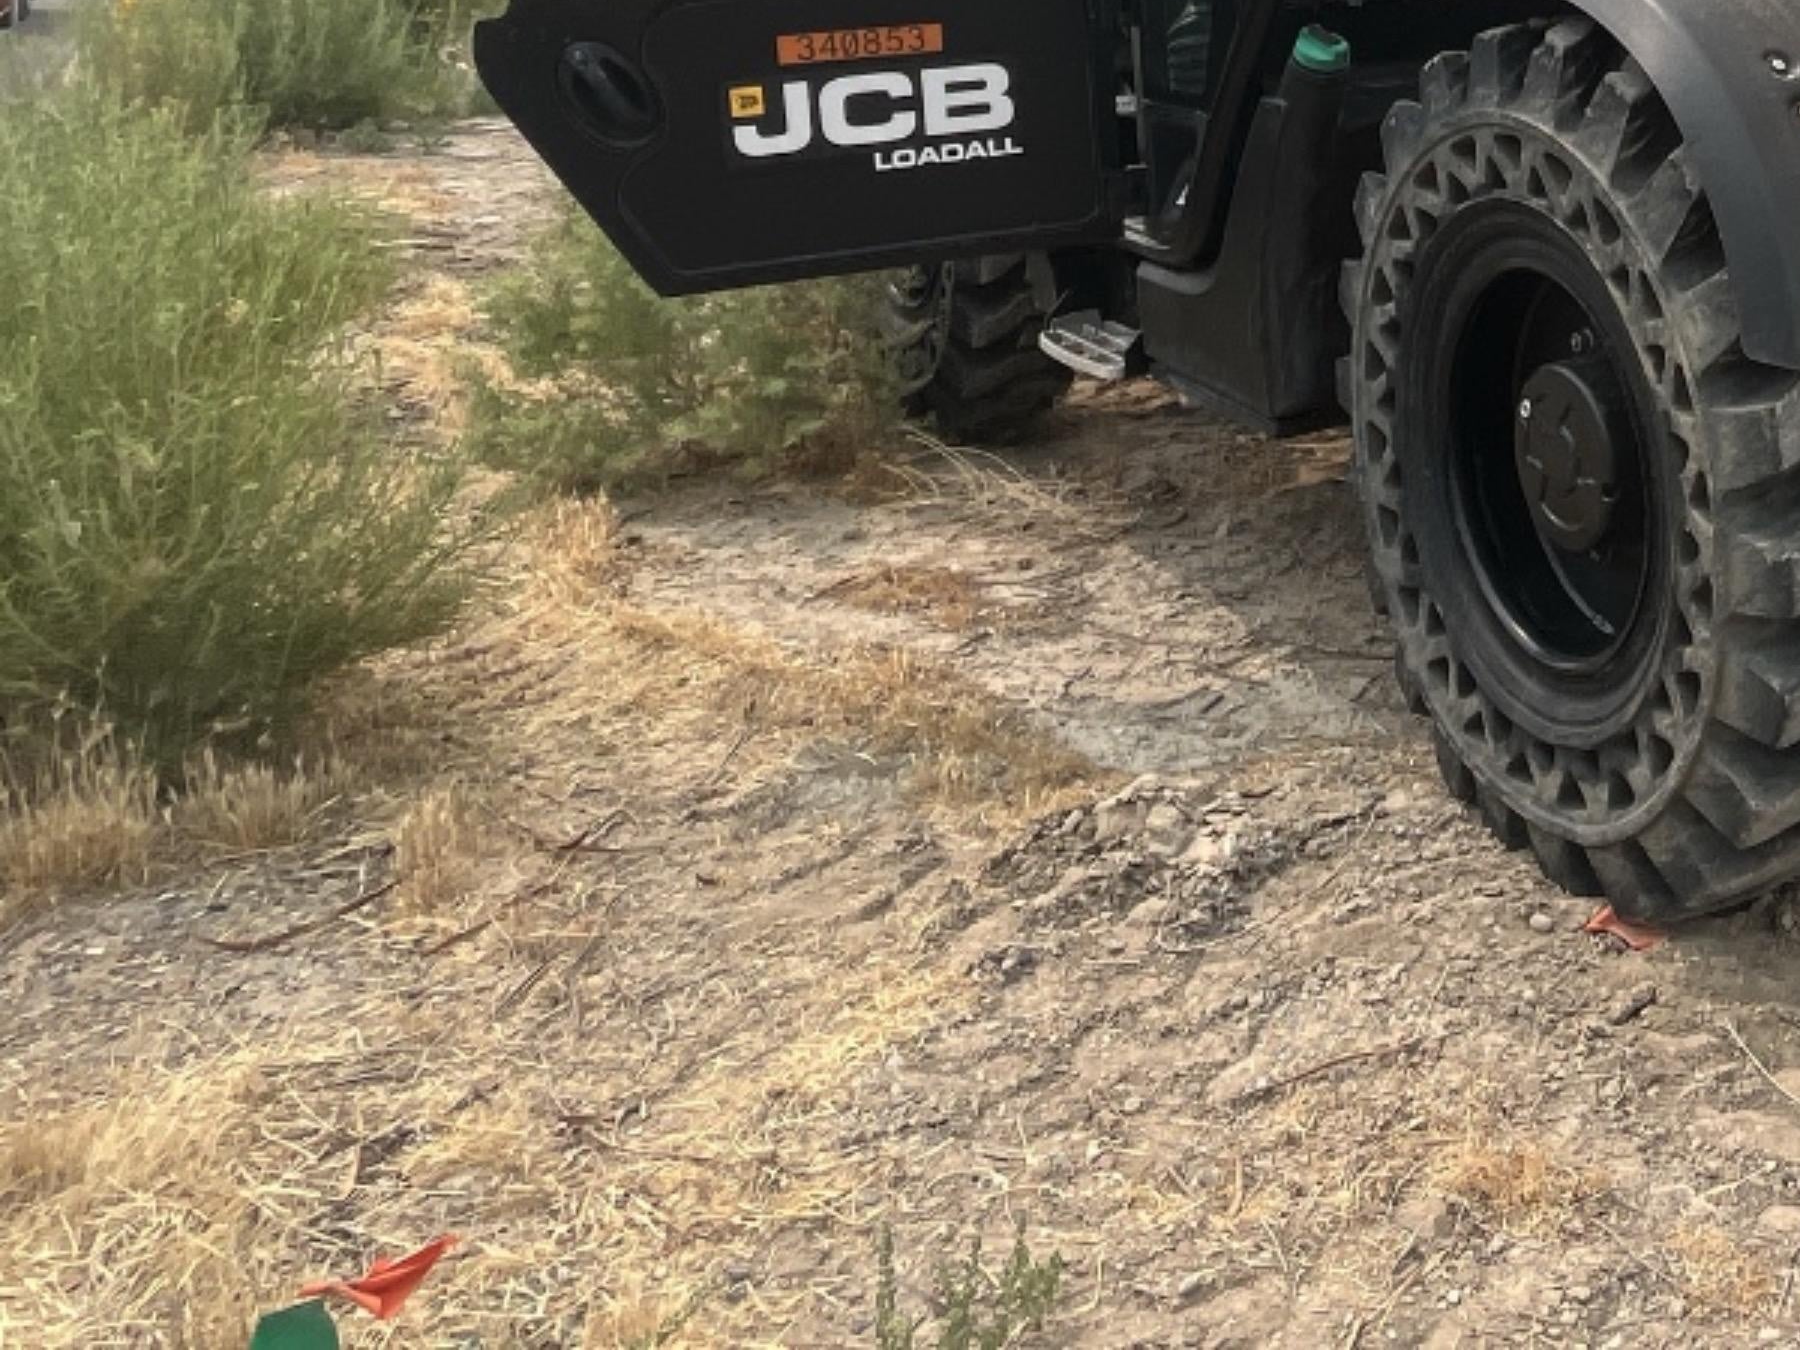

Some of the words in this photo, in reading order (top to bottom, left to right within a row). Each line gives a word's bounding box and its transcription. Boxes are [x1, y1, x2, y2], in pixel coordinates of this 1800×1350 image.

[797, 26, 925, 61] 340853
[732, 63, 1015, 157] JCB
[874, 137, 1024, 172] LOADALL
